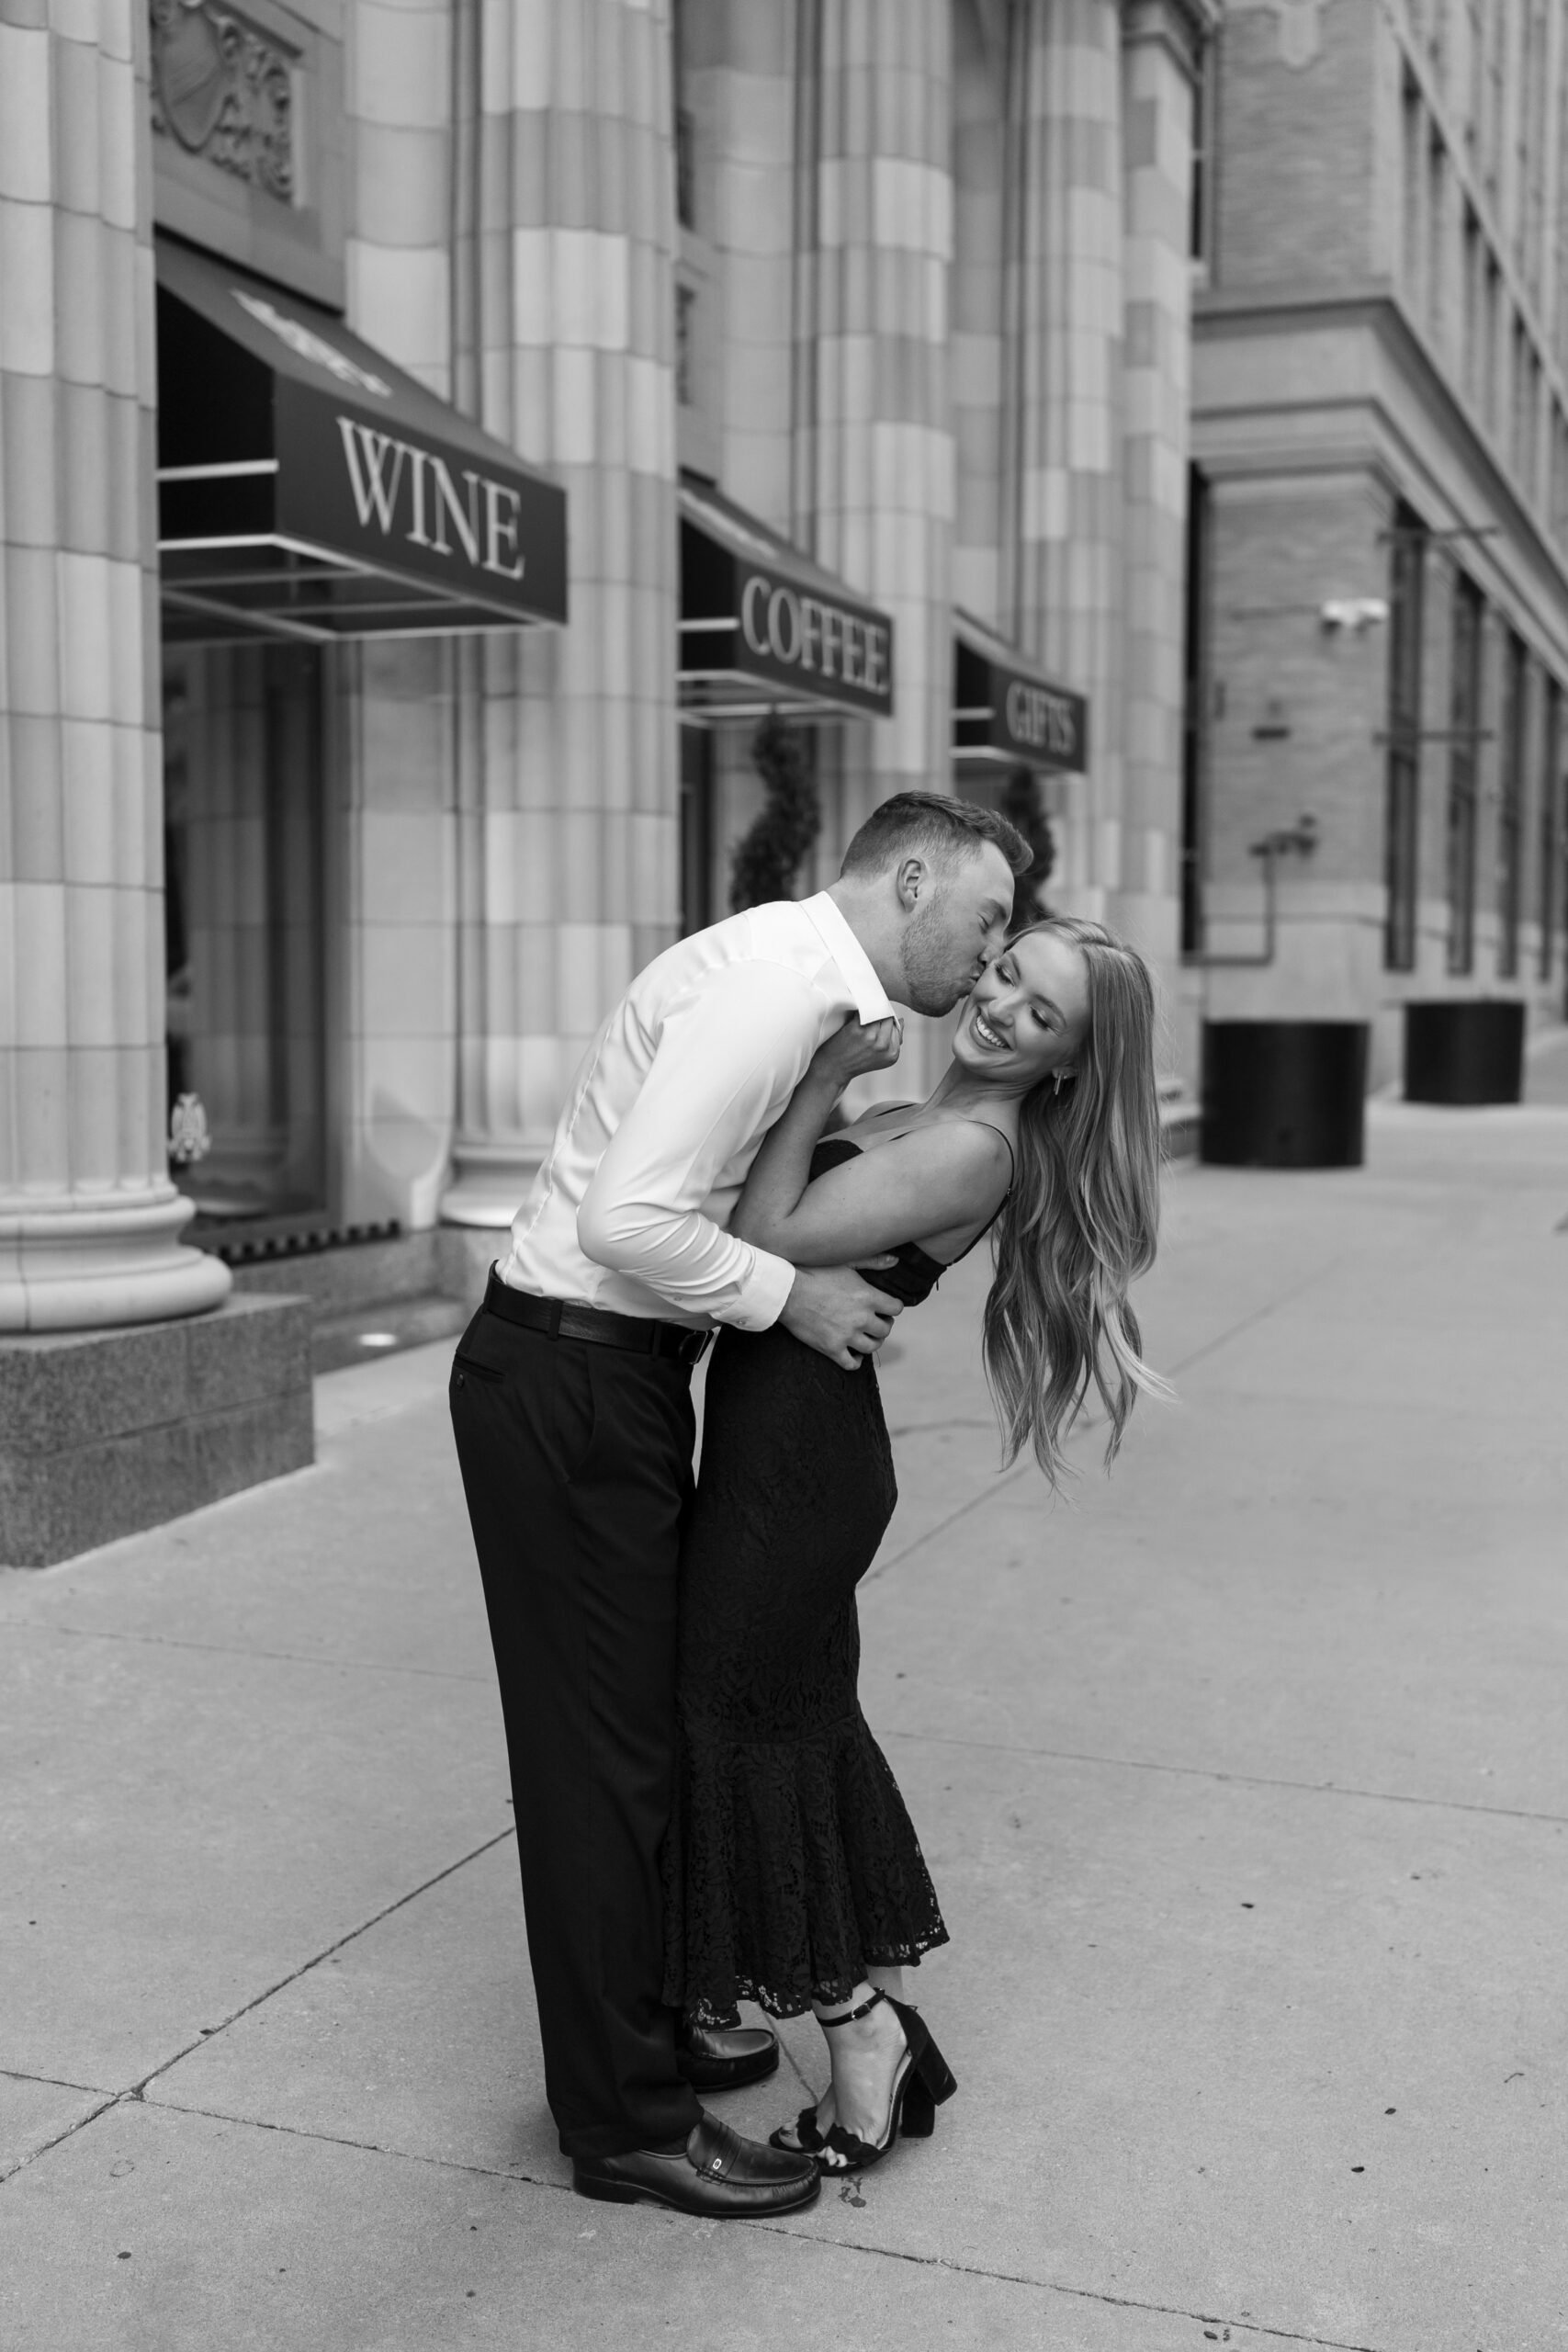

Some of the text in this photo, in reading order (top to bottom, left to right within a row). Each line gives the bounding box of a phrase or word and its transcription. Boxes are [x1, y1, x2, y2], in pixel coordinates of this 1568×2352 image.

[336, 415, 525, 580] WINE
[742, 576, 889, 695] COFFEE
[1007, 681, 1077, 755] GIFTS
